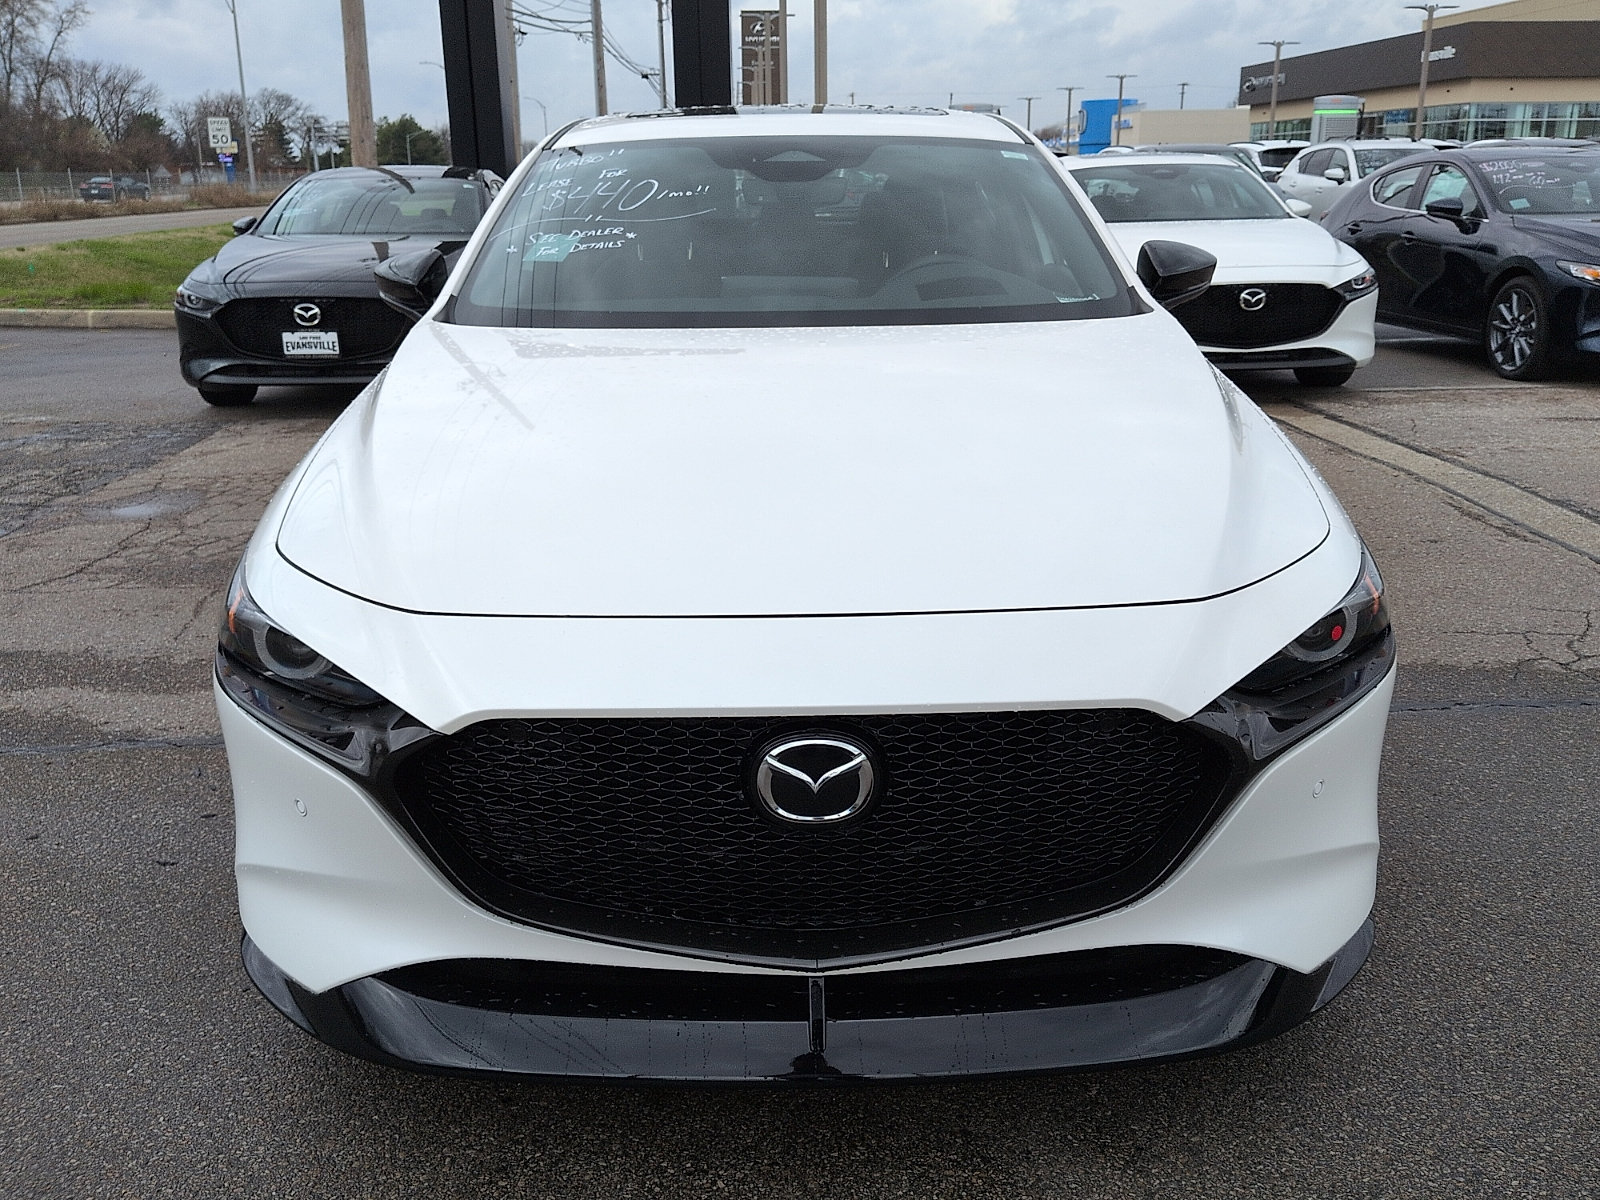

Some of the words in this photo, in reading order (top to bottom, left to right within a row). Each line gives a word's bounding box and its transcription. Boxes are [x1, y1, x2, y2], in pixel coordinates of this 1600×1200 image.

[212, 134, 229, 145] 50
[599, 168, 628, 179] FOR
[525, 232, 562, 246] SEE
[567, 226, 624, 240] DEALER
[536, 246, 560, 257] FOR
[569, 240, 625, 253] DETAILS
[285, 341, 338, 353] EVANSVILLE
